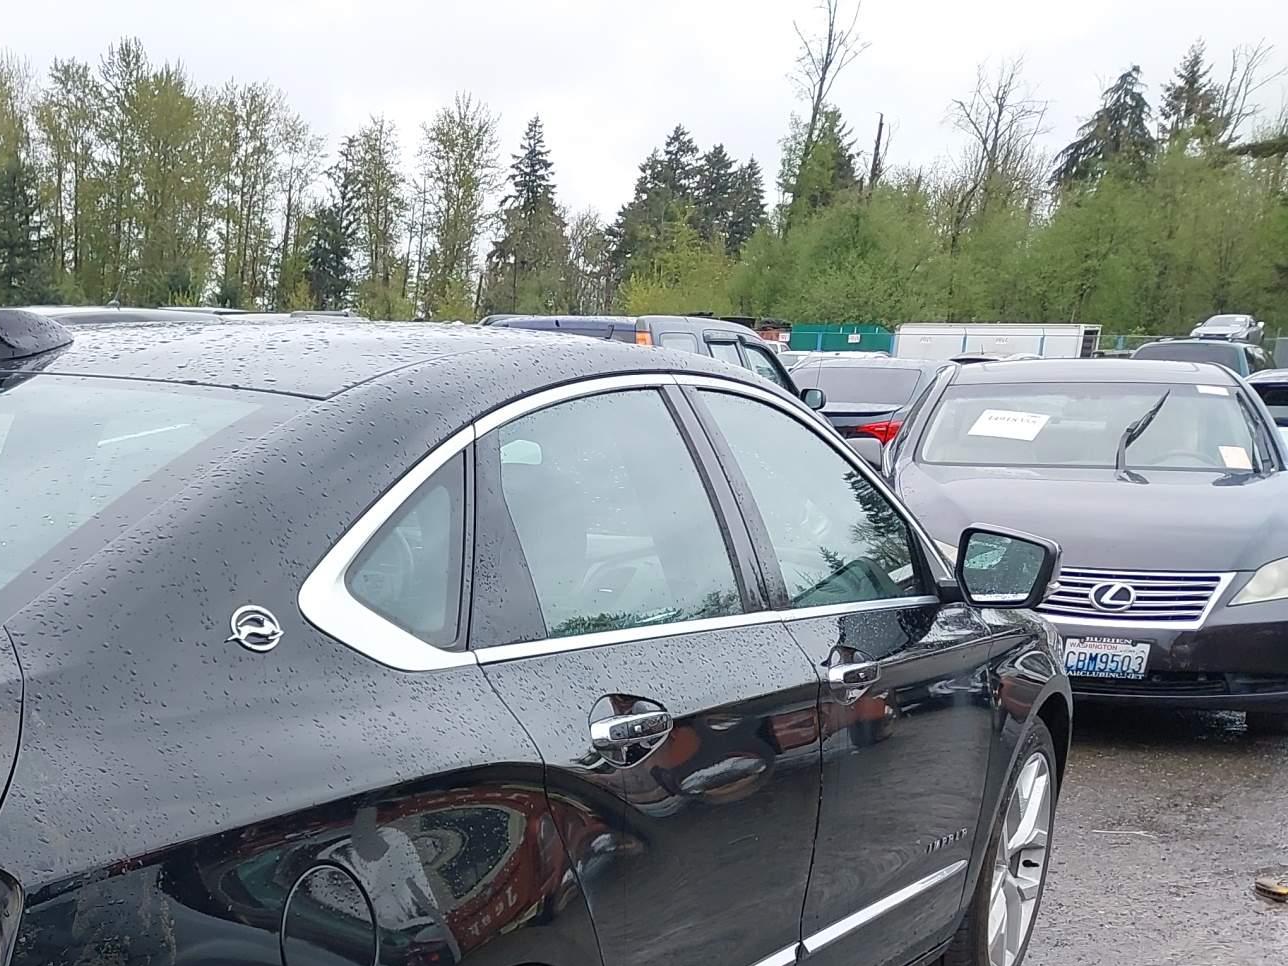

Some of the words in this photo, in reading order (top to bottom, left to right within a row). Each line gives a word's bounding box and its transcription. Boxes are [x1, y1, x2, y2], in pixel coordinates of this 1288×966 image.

[1085, 636, 1133, 645] BURIEN
[1069, 641, 1118, 651] WASHINGTON
[1064, 650, 1145, 673] CBM9503
